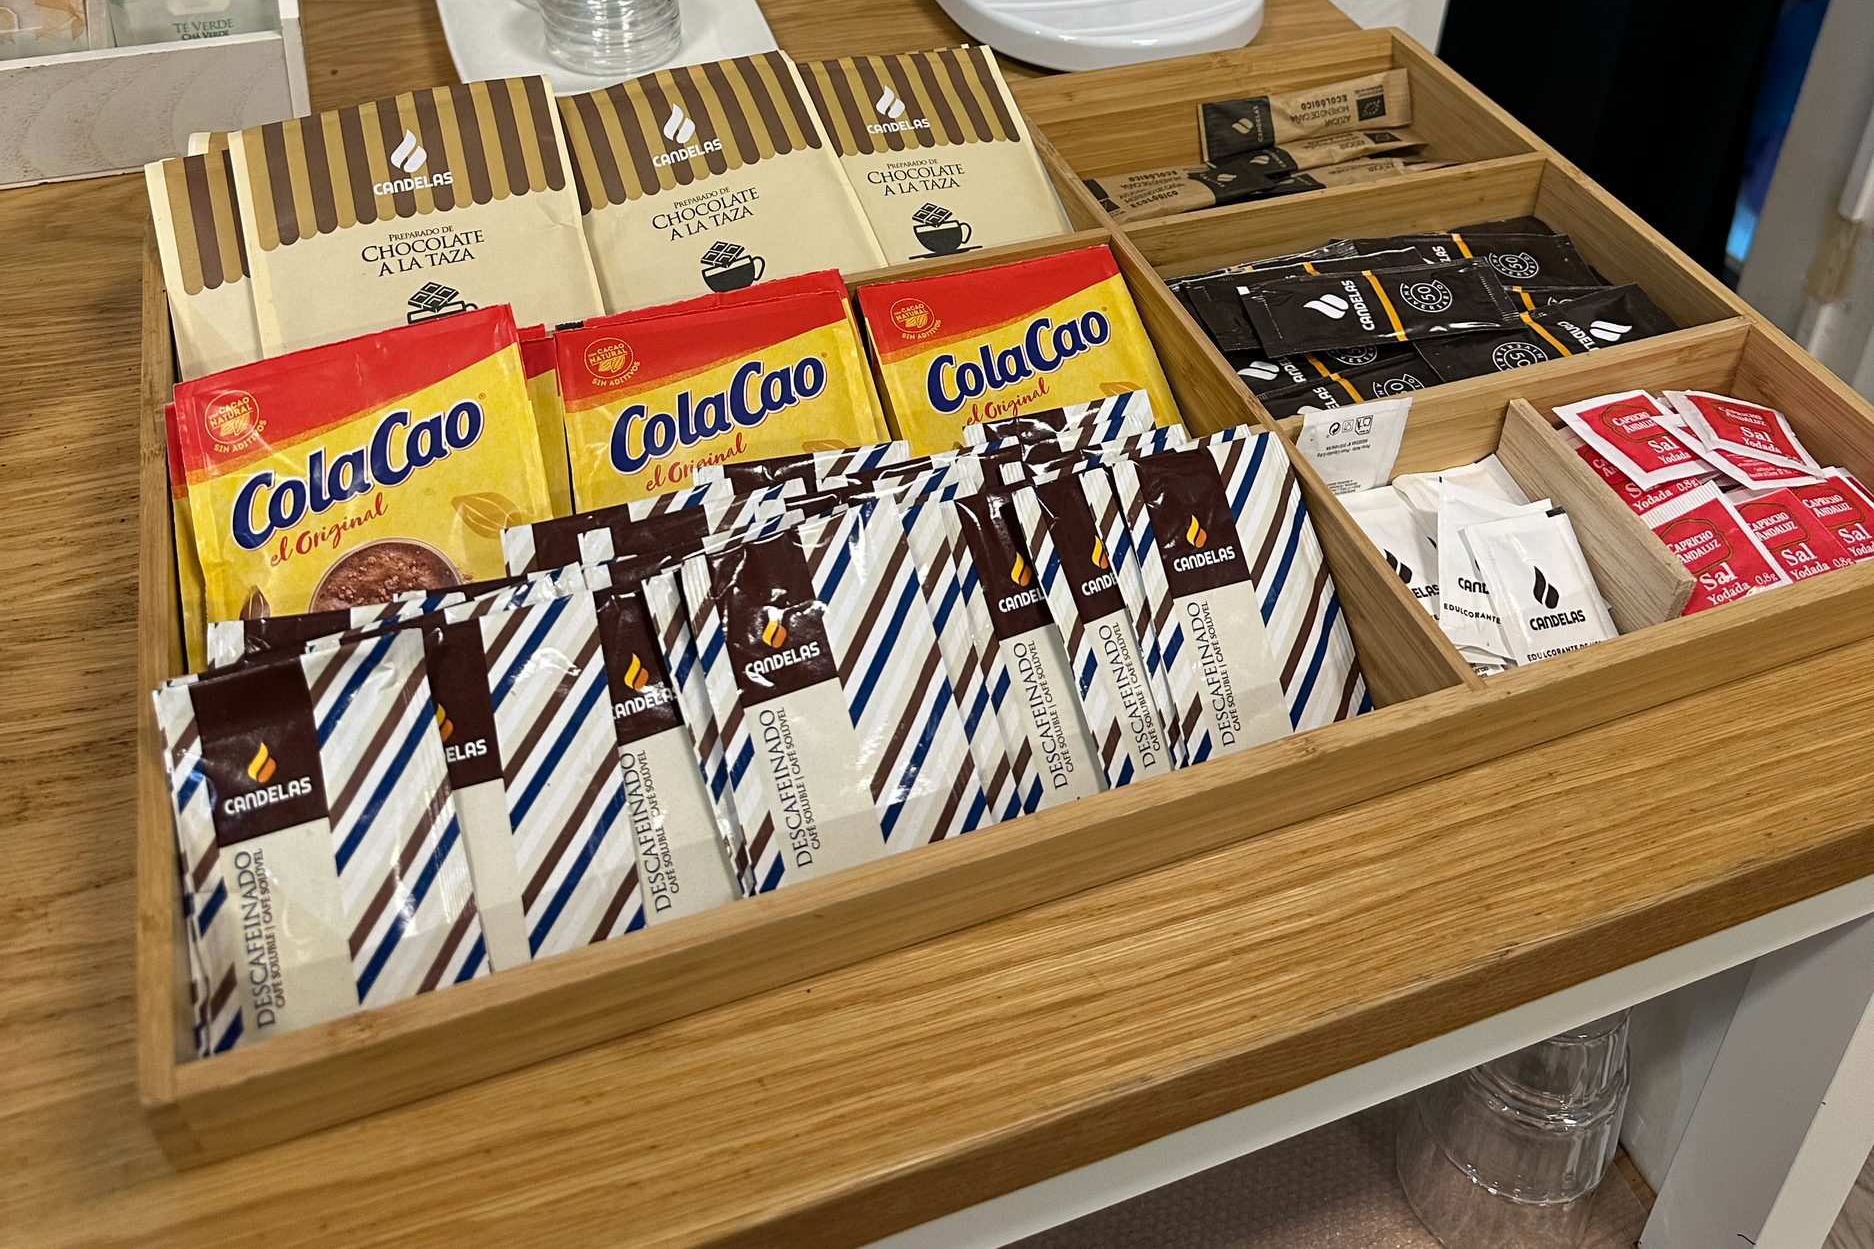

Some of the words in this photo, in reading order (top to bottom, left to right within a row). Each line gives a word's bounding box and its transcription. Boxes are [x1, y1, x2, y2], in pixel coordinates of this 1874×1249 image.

[172, 21, 190, 33] TÉ
[191, 18, 235, 31] VERDE
[866, 118, 931, 135] CANDELAS
[1253, 104, 1263, 143] CANDELAS
[651, 137, 723, 168] CANDELAS
[886, 159, 928, 170] PREPARADO
[928, 158, 939, 166] DE
[373, 171, 454, 196] CANDELAS
[866, 163, 966, 185] CHOCOLATE
[884, 184, 896, 197] A
[898, 182, 919, 194] LA
[919, 177, 961, 192] TAZA
[651, 187, 760, 231] CHOCOLATE
[673, 189, 718, 210] PREPARADO
[718, 186, 731, 196] DE
[388, 227, 441, 243] PREPARADO
[441, 224, 455, 235] DE
[670, 228, 684, 242] A
[685, 219, 709, 236] LA
[709, 205, 754, 228] TAZA
[361, 229, 485, 263] CHOCOLATE
[378, 261, 395, 278] A
[398, 255, 424, 274] LA
[426, 247, 476, 269] TAZA
[1340, 279, 1376, 332] CANDELAS
[1417, 286, 1436, 301] 50
[895, 308, 928, 322] NATURAL
[901, 303, 925, 314] CACAO
[901, 332, 916, 340] SIN
[917, 319, 942, 340] ADITIVOS
[1556, 321, 1600, 352] CANDEL
[588, 348, 628, 365] NATURAL
[597, 343, 625, 355] CACAO
[926, 310, 1110, 414] ColaCao
[591, 377, 607, 387] SIN
[609, 360, 641, 387] ADITIVOS
[1277, 356, 1308, 384] ANDEL
[218, 396, 250, 415] CACAO
[966, 403, 984, 426] el
[984, 376, 1051, 420] Original
[209, 403, 253, 428] NATURAL
[609, 356, 827, 475] ColaCao
[1611, 410, 1651, 427] CAPRICHO
[213, 442, 230, 453] SIN
[232, 419, 268, 452] ADITIVOS
[1647, 435, 1680, 454] Sal
[1740, 425, 1774, 444] Sal
[1741, 436, 1783, 455] Yodada
[1657, 450, 1692, 465] Yodada
[231, 398, 485, 551] ColaCao
[645, 464, 667, 492] el
[1632, 489, 1674, 512] Yodada
[1676, 478, 1699, 492] 0,8g
[1802, 494, 1844, 508] CAPRICHO
[1813, 502, 1853, 518] ANDALUZ
[270, 537, 293, 568] el
[295, 492, 389, 556] Original
[1754, 520, 1798, 542] ANDALUZ
[1837, 523, 1873, 544] Sal
[1173, 545, 1236, 573] CANDELAS
[1676, 538, 1722, 564] ANDALUZ
[1781, 542, 1818, 567] Sal
[1847, 540, 1874, 557] Yodad
[1699, 561, 1739, 592] Sal
[1790, 561, 1831, 581] Yodada
[1832, 557, 1854, 569] 0,8g
[998, 587, 1046, 613] CANDEL
[1706, 581, 1751, 606] Yodada
[1754, 571, 1779, 586] 0,8g
[1443, 602, 1501, 625] EDULCORANTE
[1529, 609, 1587, 631] CANDELAS
[744, 641, 821, 680] CANDELAS
[1526, 644, 1579, 662] EDULCORANTE
[1186, 601, 1236, 747] DESCAFEINADO
[1098, 624, 1157, 769] DESCAFEINADO
[1219, 670, 1237, 708] SOLUBLE
[1013, 641, 1069, 790] DESCAFEINADO
[1135, 689, 1155, 728] SOLUBLE
[1047, 710, 1068, 751] SOLUBLE
[444, 738, 488, 763] ELAS
[224, 776, 313, 816] CANDELAS
[758, 709, 814, 869] DESCAFEINADO
[795, 781, 815, 824] SOLUBLE
[618, 752, 673, 914] DESCAFEINADO
[655, 825, 674, 868] SOLUBLE
[234, 850, 277, 1030] DESCAFEINADO
